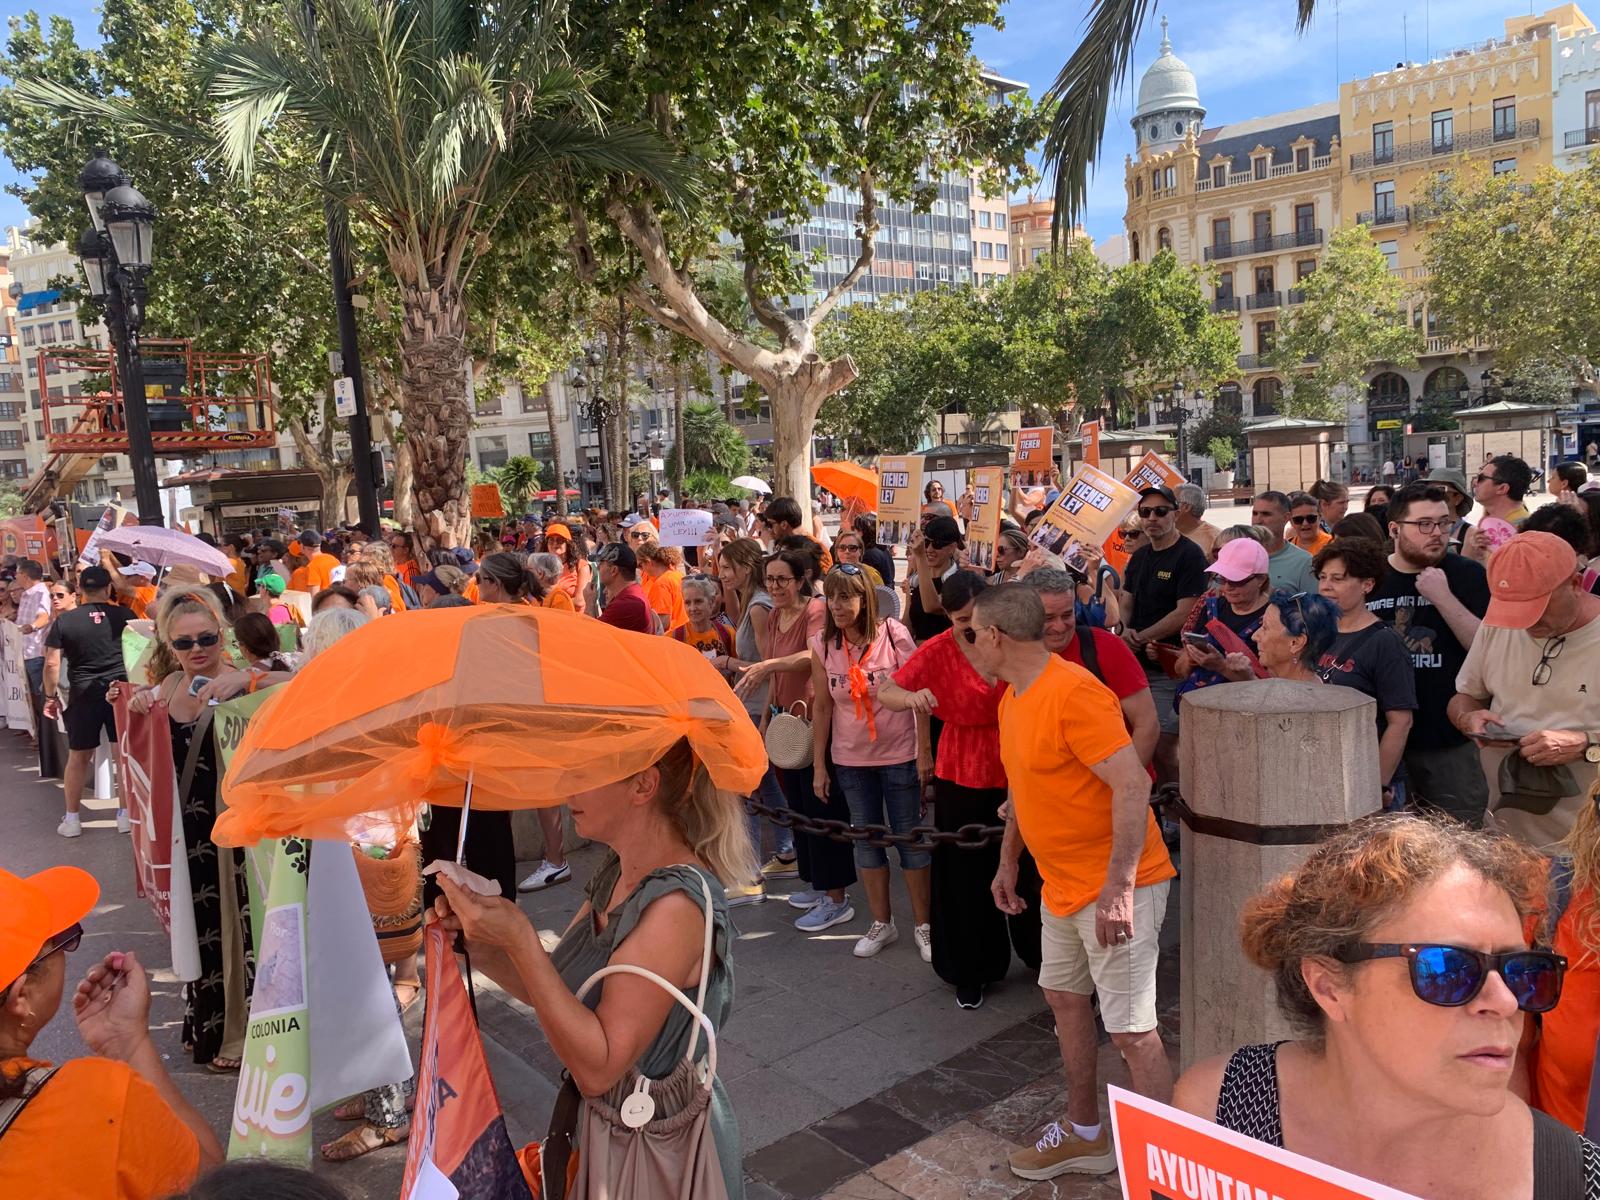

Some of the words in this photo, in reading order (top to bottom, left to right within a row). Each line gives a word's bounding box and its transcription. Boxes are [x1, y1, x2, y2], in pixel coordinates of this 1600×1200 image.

[1020, 440, 1041, 450] TIENEN
[1018, 451, 1029, 460] LEY
[882, 472, 909, 488] TIENEN
[1129, 474, 1146, 489] LEY
[881, 489, 895, 504] LEY
[1070, 480, 1113, 512] TIENEN
[255, 504, 299, 514] MONTAANA
[1060, 494, 1084, 515] LEY
[251, 1017, 301, 1039] COLONIA
